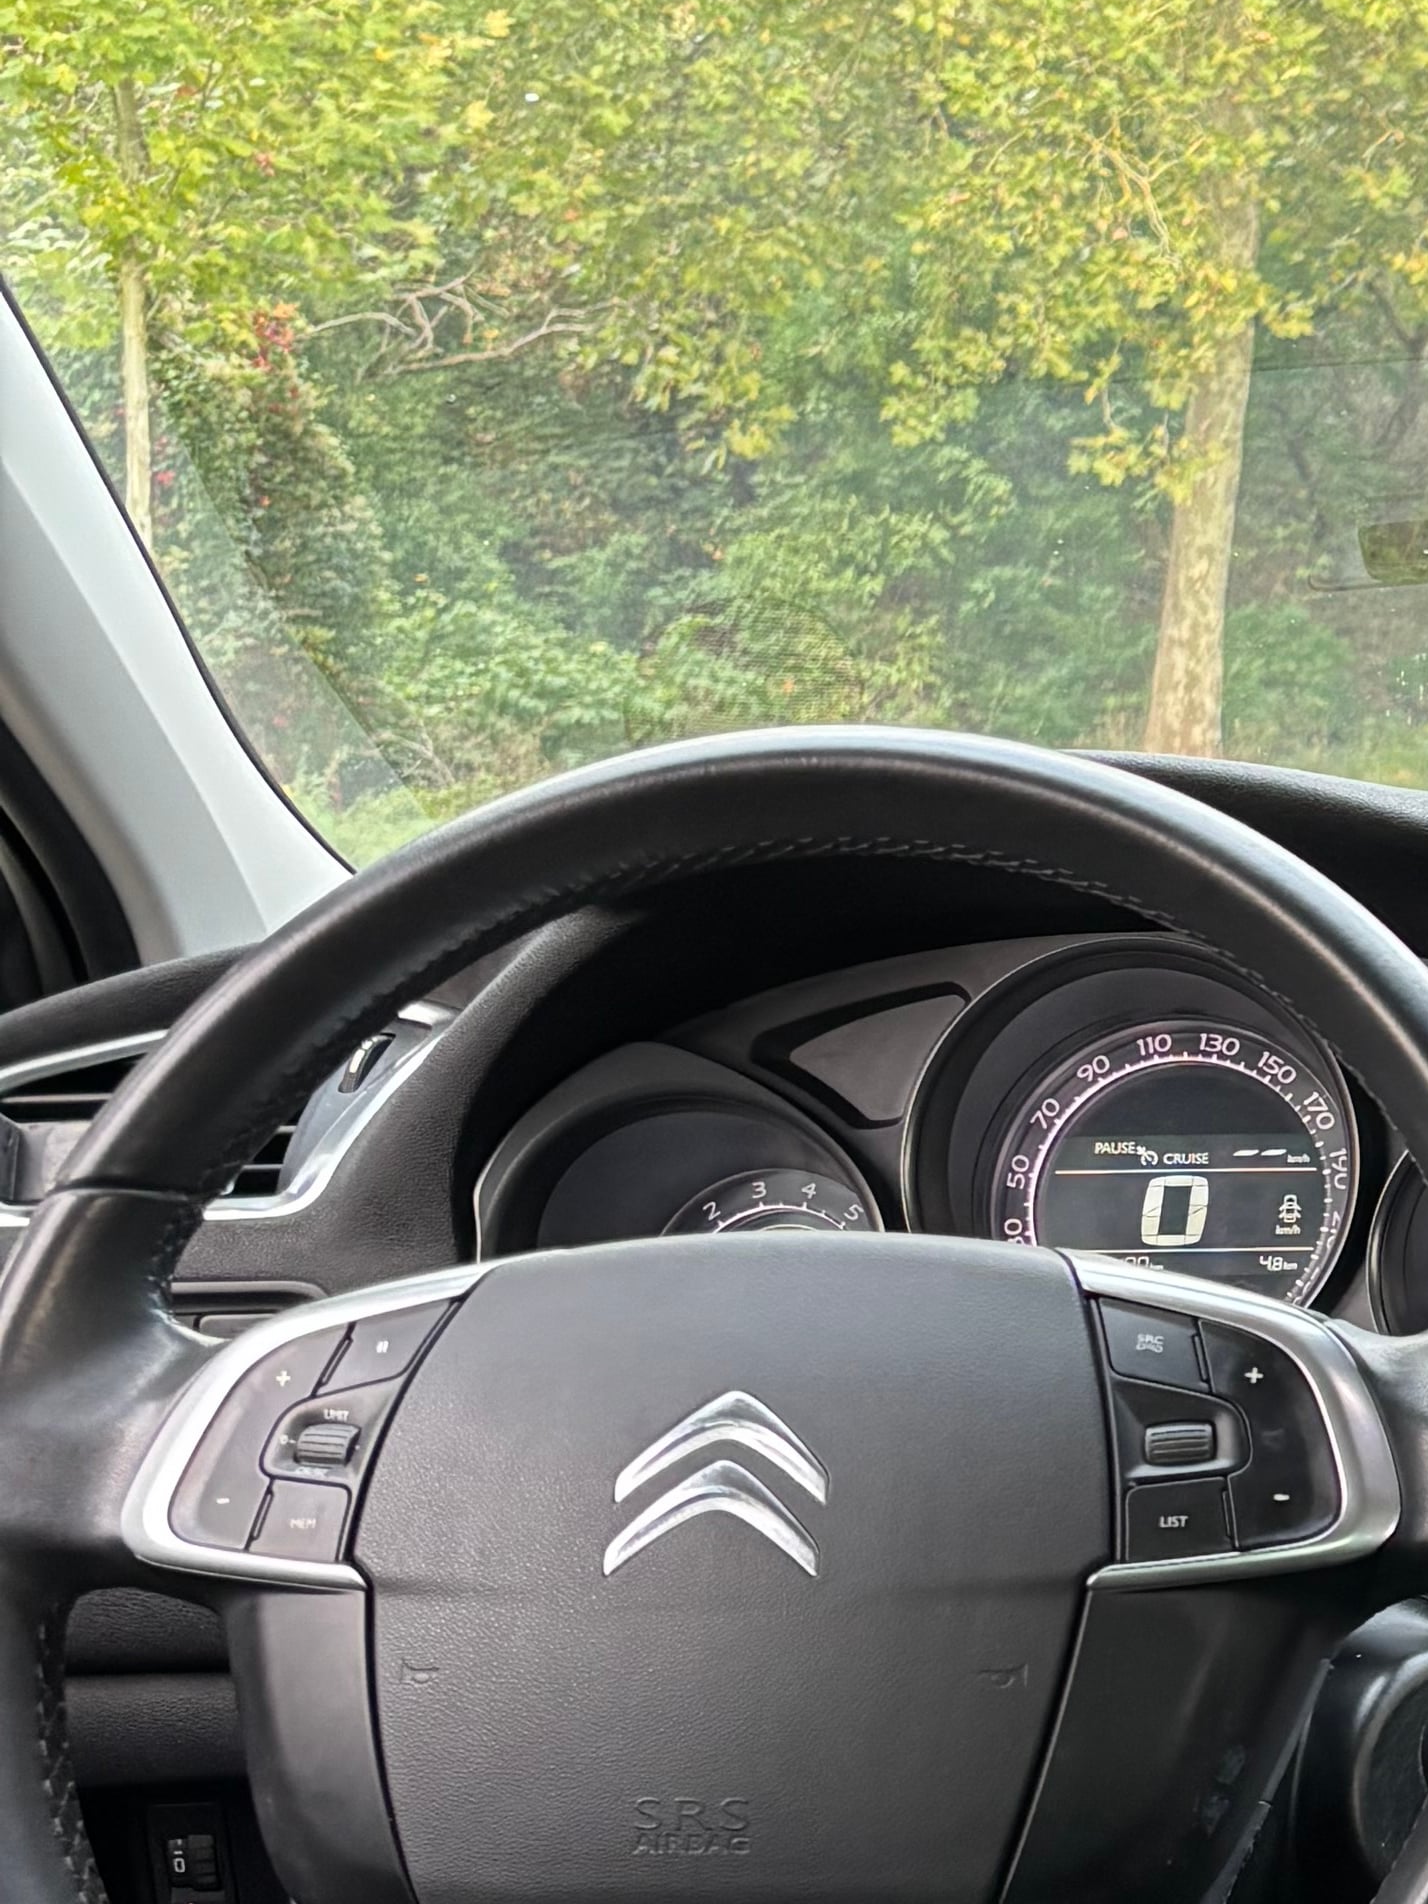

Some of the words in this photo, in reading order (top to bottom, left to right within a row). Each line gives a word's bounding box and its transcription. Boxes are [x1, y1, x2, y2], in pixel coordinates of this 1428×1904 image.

[1135, 1033, 1173, 1056] 110
[1199, 1032, 1241, 1057] 130
[1076, 1054, 1111, 1083] 90
[1257, 1050, 1297, 1085] 150
[1029, 1097, 1061, 1130] 70
[1301, 1091, 1336, 1131] 170
[1094, 1141, 1136, 1155] PAUSE
[1162, 1152, 1210, 1166] CRUISE
[1006, 1154, 1030, 1190] 50
[752, 1181, 767, 1198] 3
[801, 1182, 817, 1199] 4
[702, 1200, 722, 1221] 2
[844, 1203, 865, 1221] 5
[1140, 1174, 1209, 1247] 0
[289, 1517, 317, 1530] MEM
[1157, 1514, 1189, 1529] LIST
[633, 1796, 750, 1832] SRS
